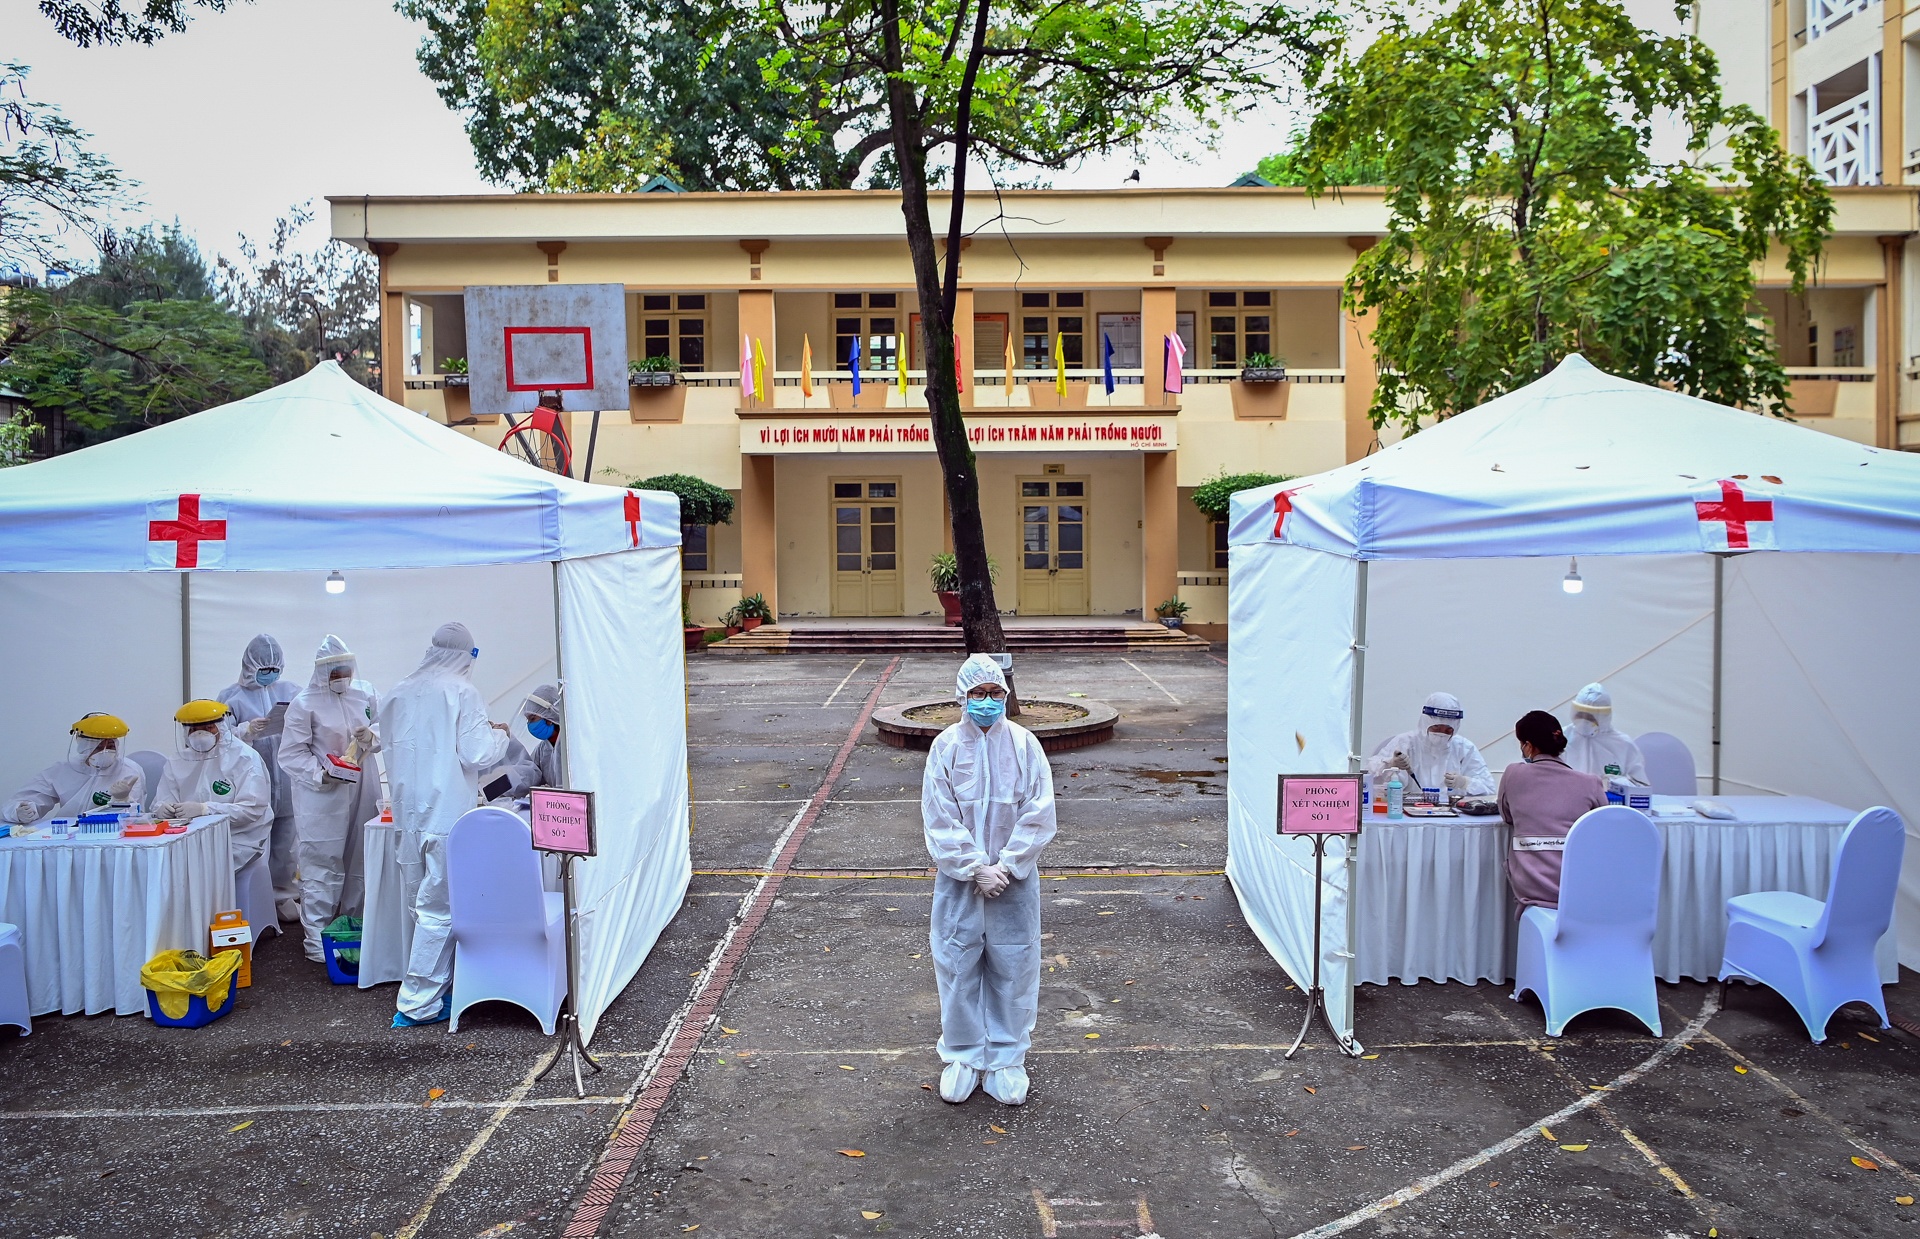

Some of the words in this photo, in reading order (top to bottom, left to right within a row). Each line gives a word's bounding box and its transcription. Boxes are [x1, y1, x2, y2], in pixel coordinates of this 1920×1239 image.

[760, 427, 770, 443] VÌ
[774, 429, 790, 446] LỢI
[794, 427, 809, 443] ÍCH
[813, 425, 839, 443] MƯỜI
[842, 427, 866, 443] NĂM
[869, 424, 893, 443] PHẢI
[968, 427, 985, 444] LỢI
[988, 425, 1005, 441] ÍCH
[1008, 425, 1037, 441] TRĂM
[1040, 425, 1065, 441] NĂM
[1067, 422, 1092, 441] PHẢI
[1131, 424, 1162, 441] NGƯỜI
[1305, 785, 1338, 795] PHÒNG
[546, 800, 571, 811] PHÒNG
[1312, 800, 1350, 810] NGHIỆM
[551, 815, 581, 826] NGHIỆM
[562, 830, 566, 838] 2
